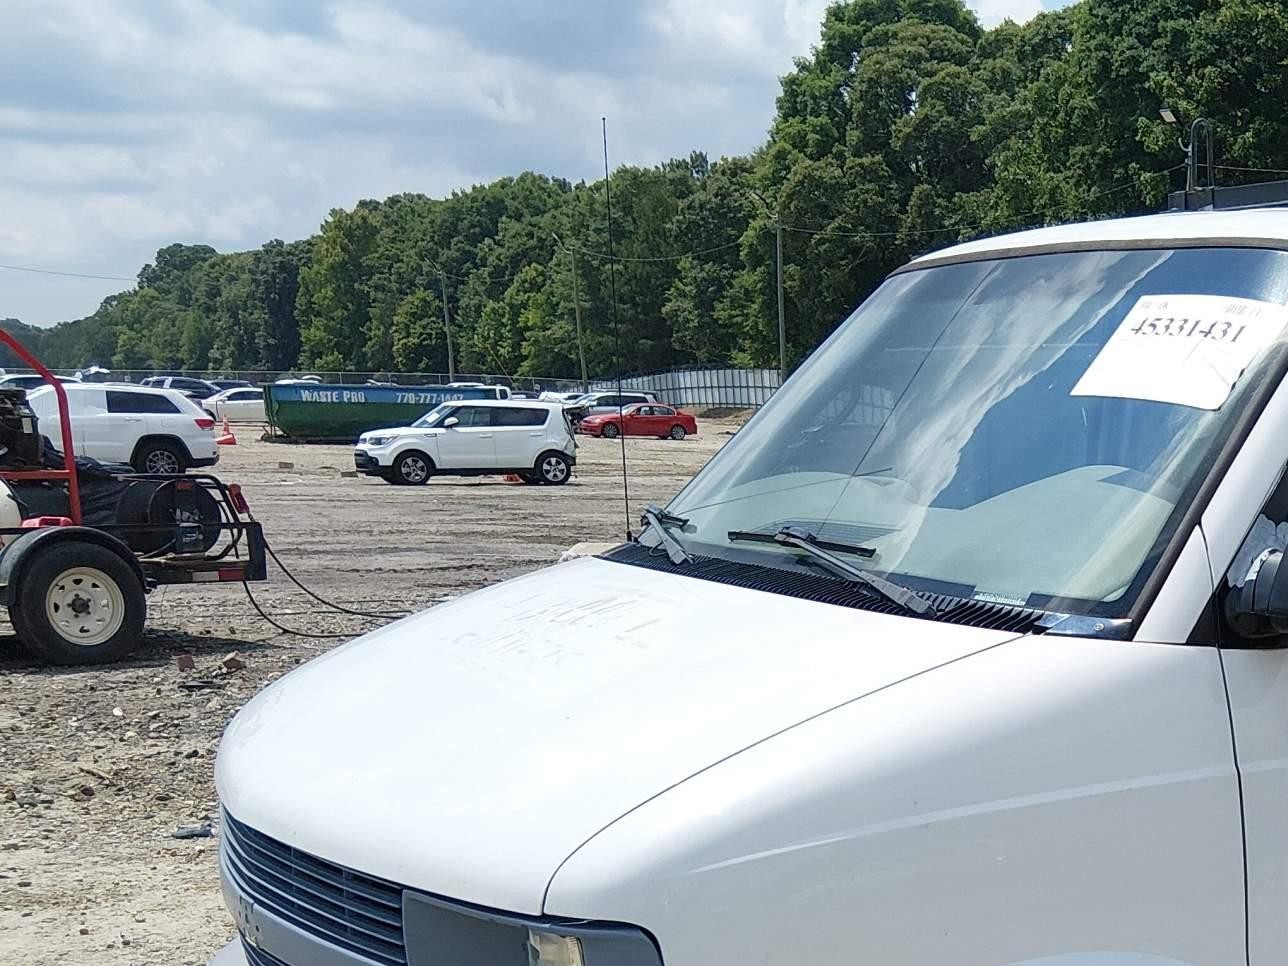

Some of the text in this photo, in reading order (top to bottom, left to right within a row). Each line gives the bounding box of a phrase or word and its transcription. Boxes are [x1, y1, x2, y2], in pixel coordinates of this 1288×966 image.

[1130, 317, 1247, 343] 45331431
[300, 390, 339, 402] WASTE
[343, 391, 365, 403] PRO
